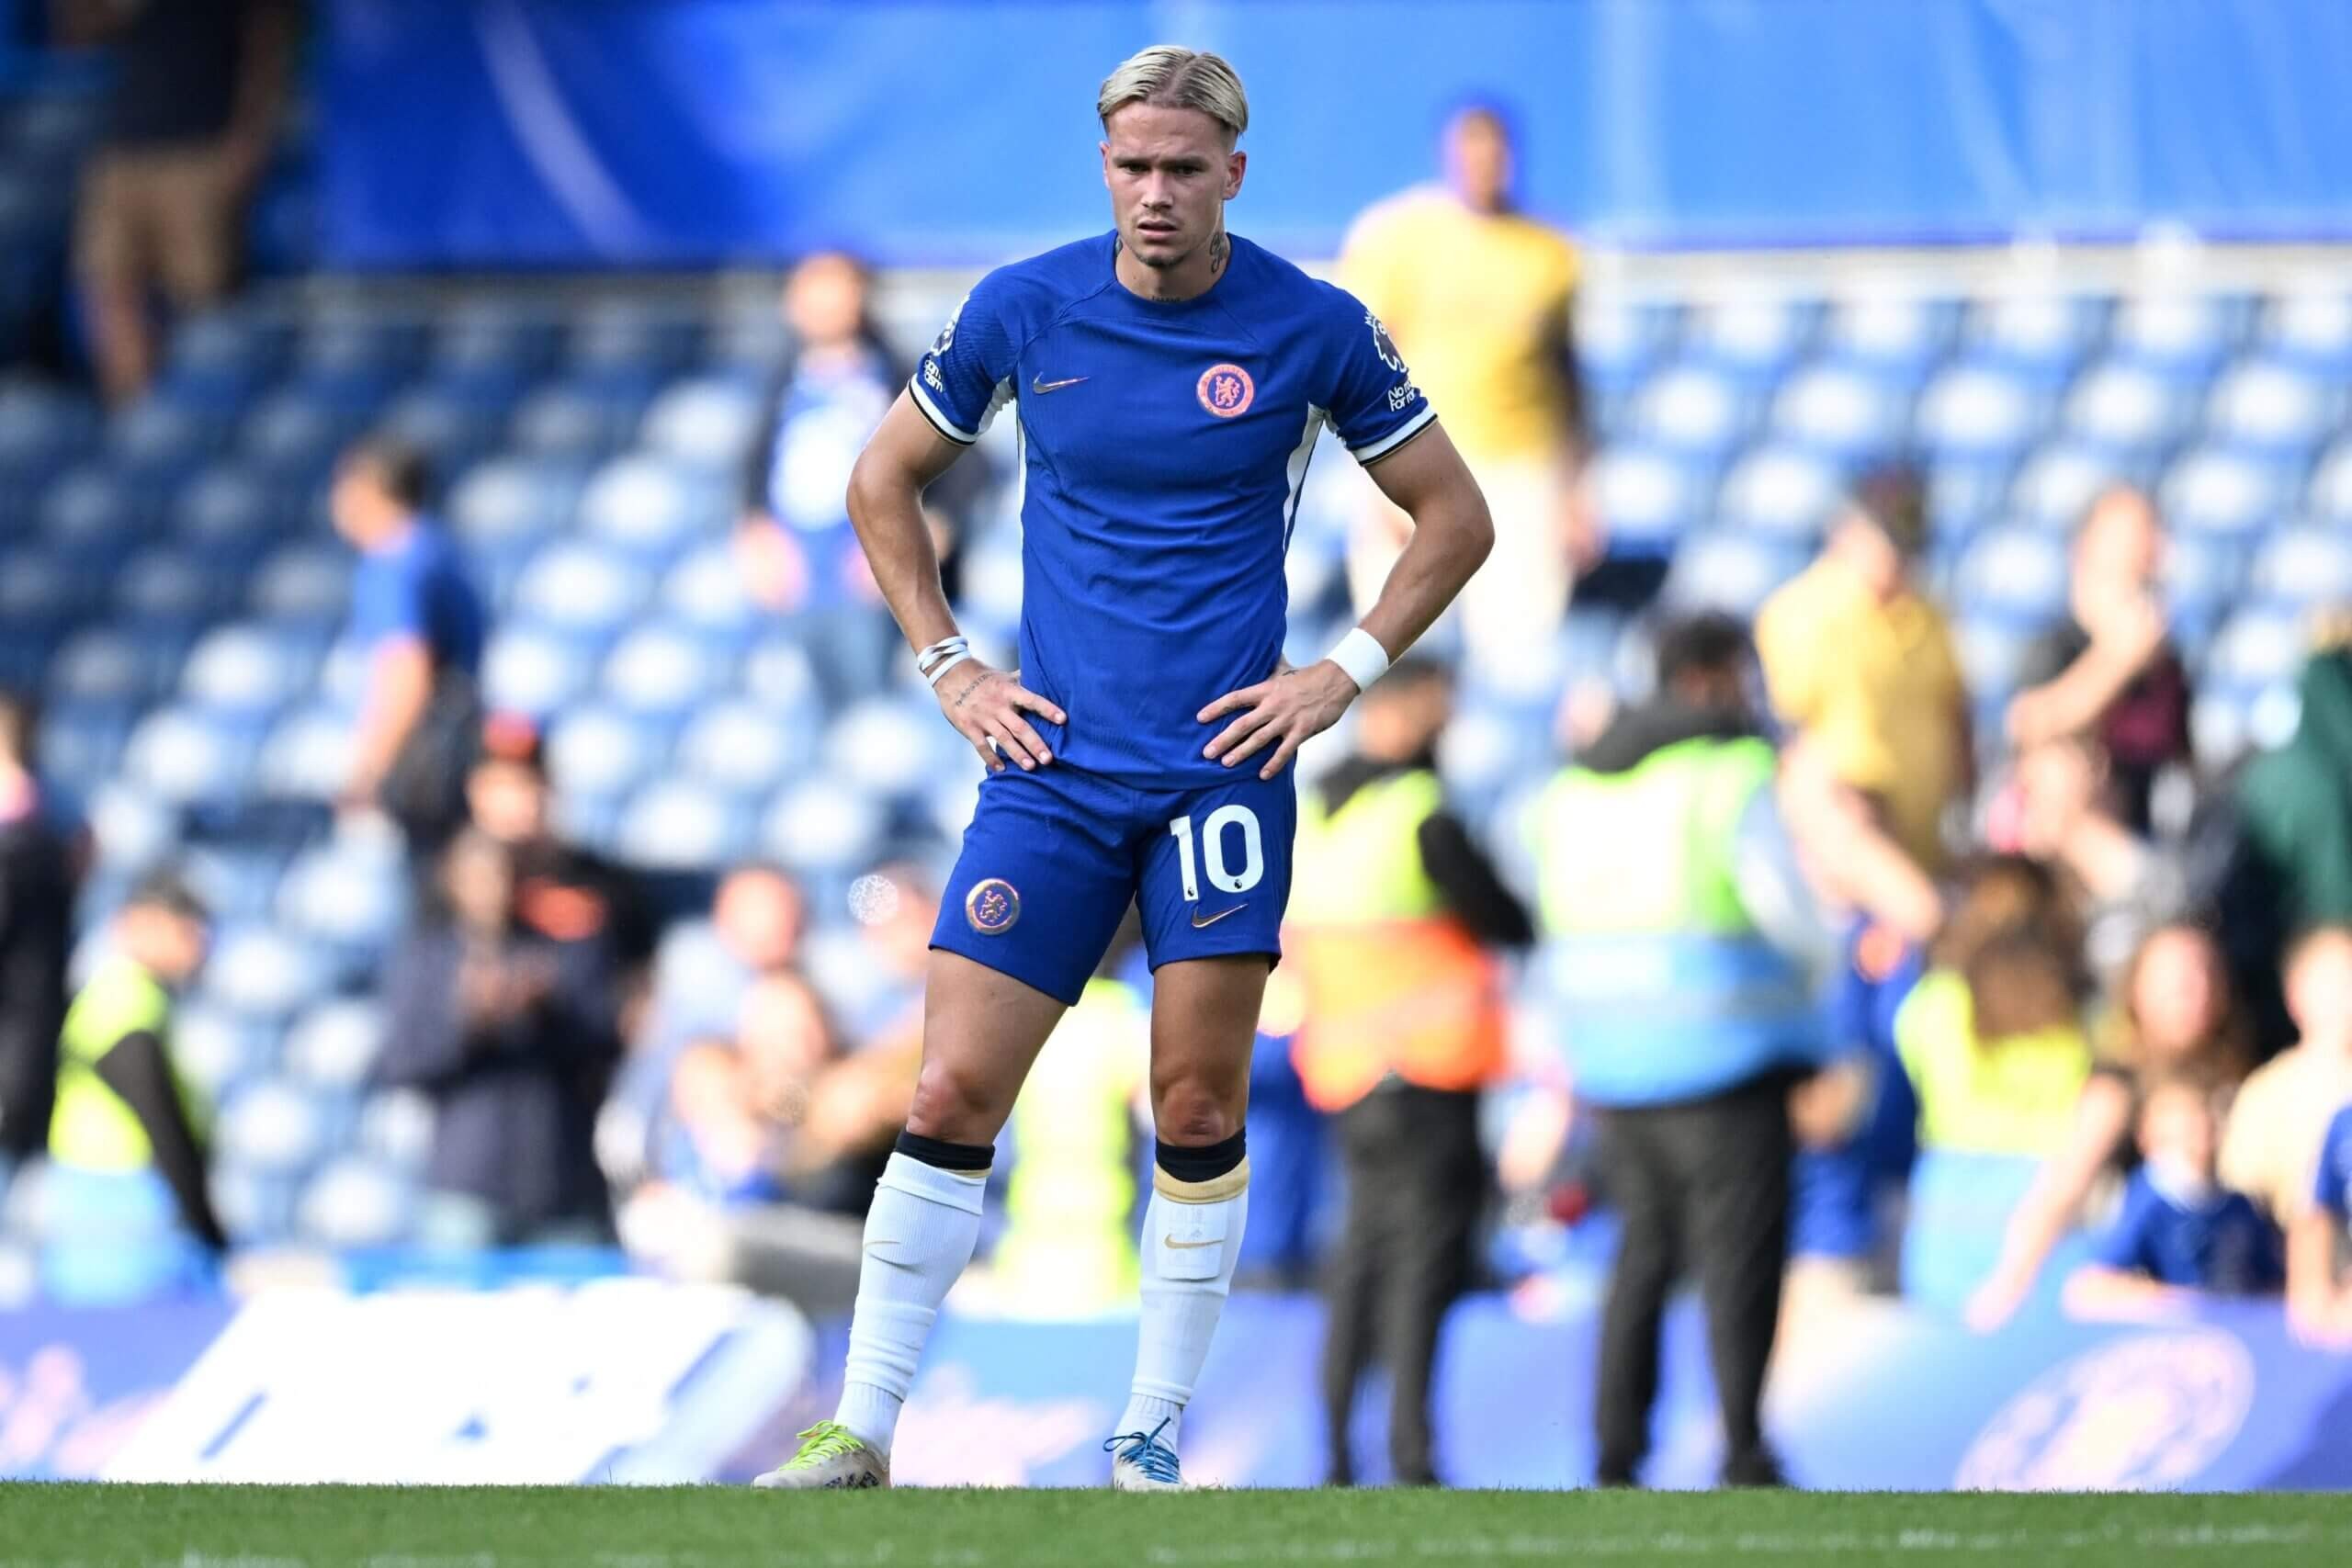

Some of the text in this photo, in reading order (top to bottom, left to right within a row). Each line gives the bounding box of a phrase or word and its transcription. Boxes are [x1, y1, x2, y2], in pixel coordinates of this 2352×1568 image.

[1388, 386, 1405, 399] No
[1390, 396, 1406, 412] For
[1170, 805, 1264, 901] 10
